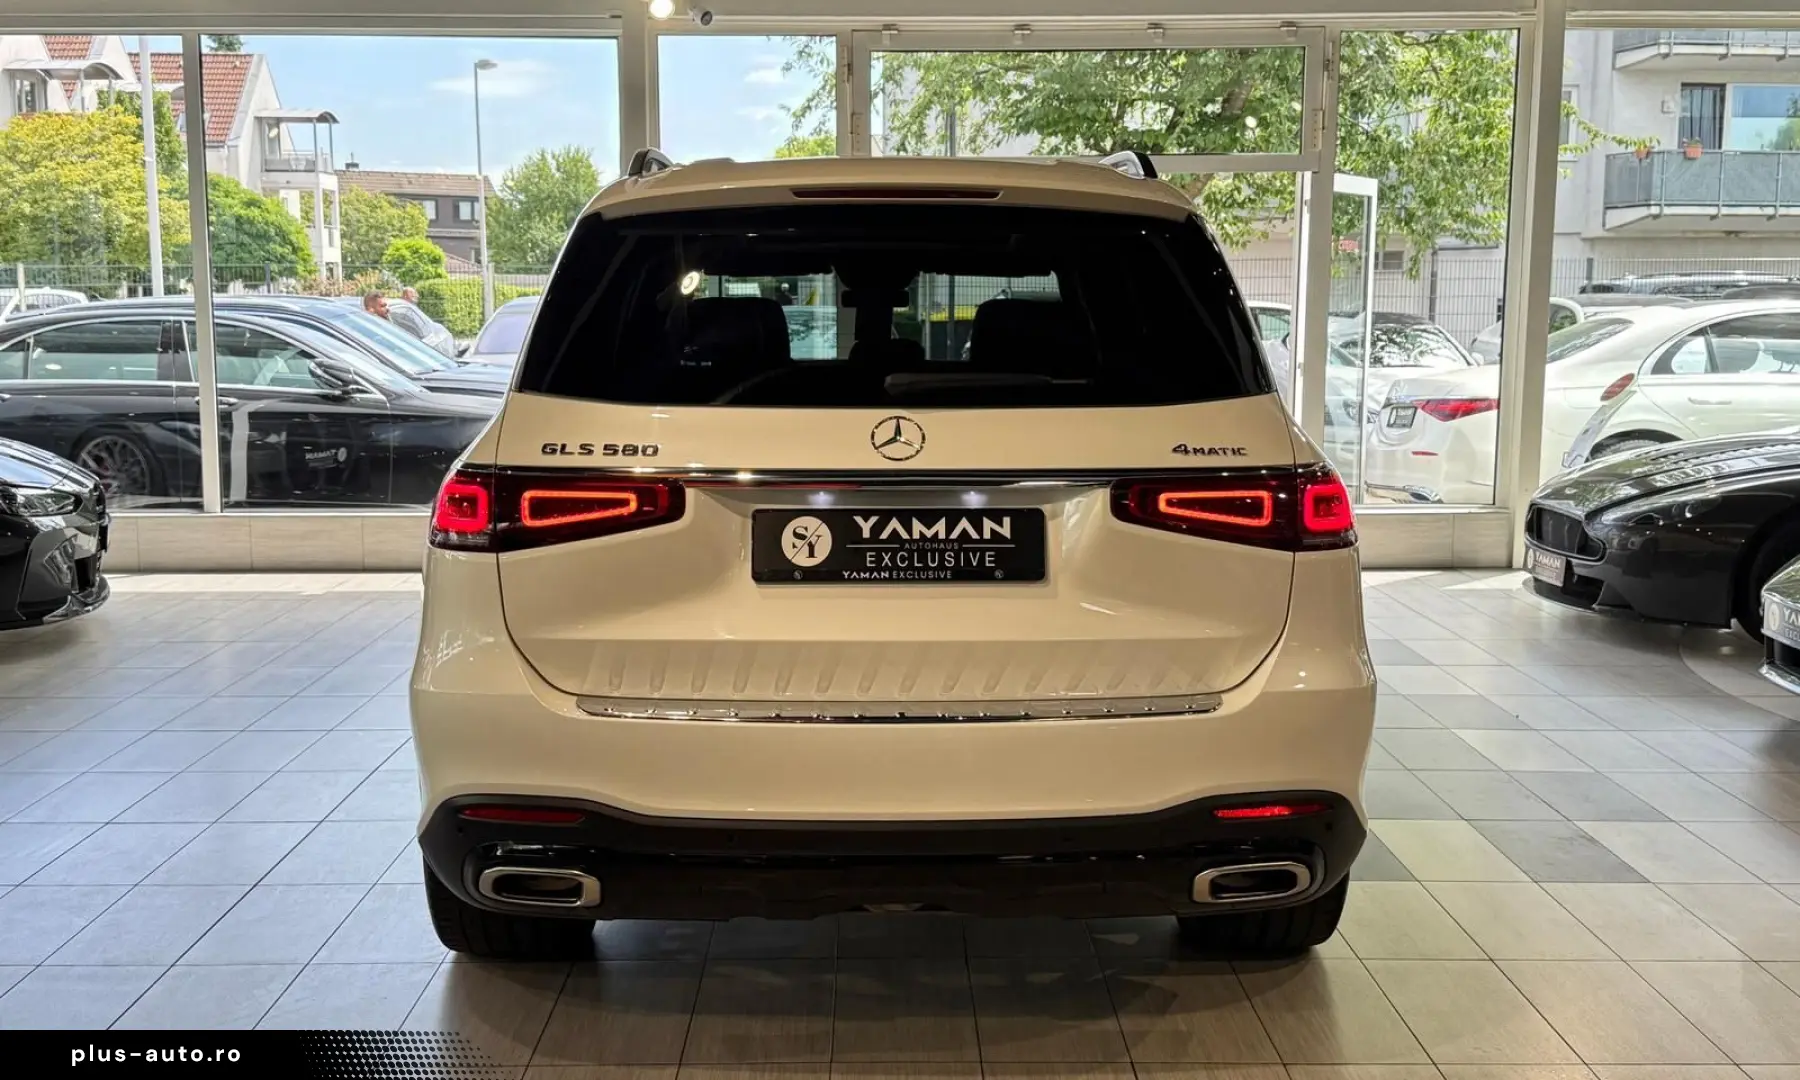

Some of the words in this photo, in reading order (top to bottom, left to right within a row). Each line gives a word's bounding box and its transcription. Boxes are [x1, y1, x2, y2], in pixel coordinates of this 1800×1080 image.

[541, 443, 594, 456] GLS
[602, 443, 659, 457] 580
[1172, 443, 1247, 457] 4MATIC
[853, 515, 1011, 540] YAMAN
[904, 542, 959, 550] AUTOHAUS
[866, 551, 996, 567] EXCLUSIVE
[842, 570, 889, 579] YAMAN
[892, 570, 952, 579] EXCLUSIVE
